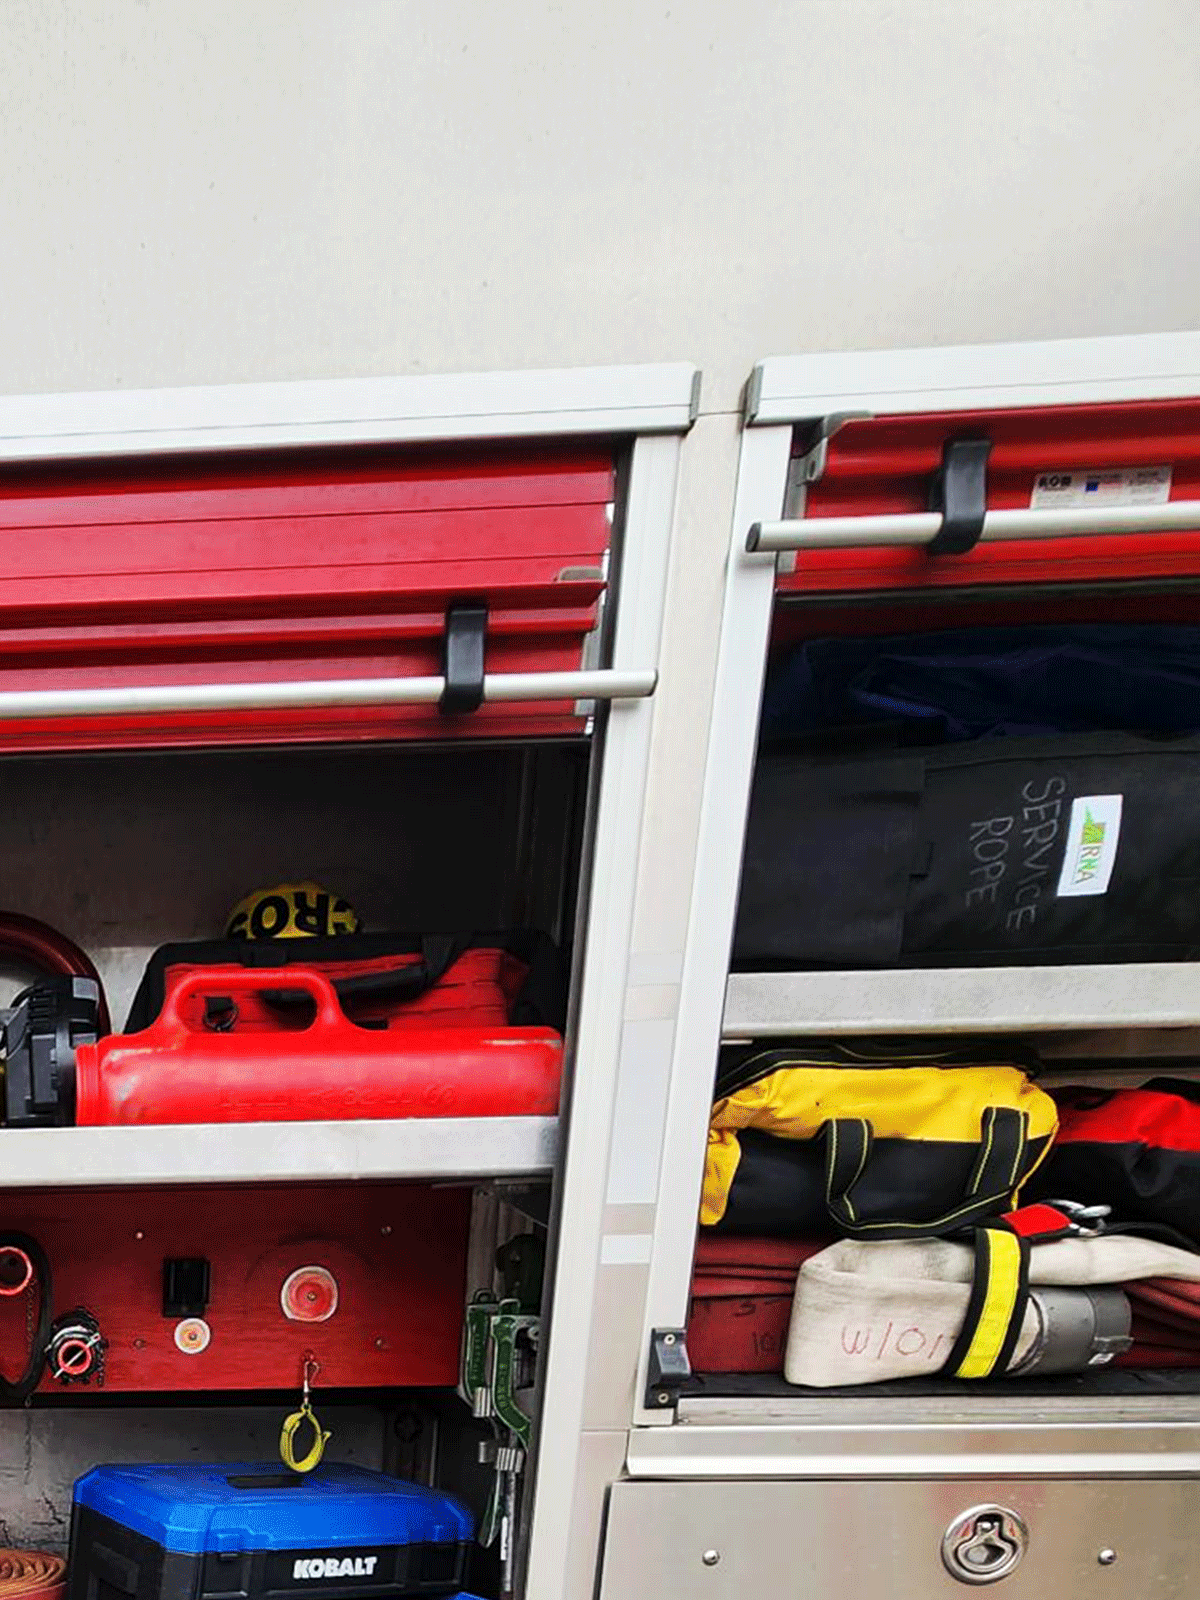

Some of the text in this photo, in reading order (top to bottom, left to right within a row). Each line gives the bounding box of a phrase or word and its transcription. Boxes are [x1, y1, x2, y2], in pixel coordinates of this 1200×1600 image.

[965, 816, 1014, 908] ROPE
[1005, 776, 1066, 931] SERVICE
[1074, 845, 1102, 885] RNA
[293, 1556, 378, 1580] KOBALT
